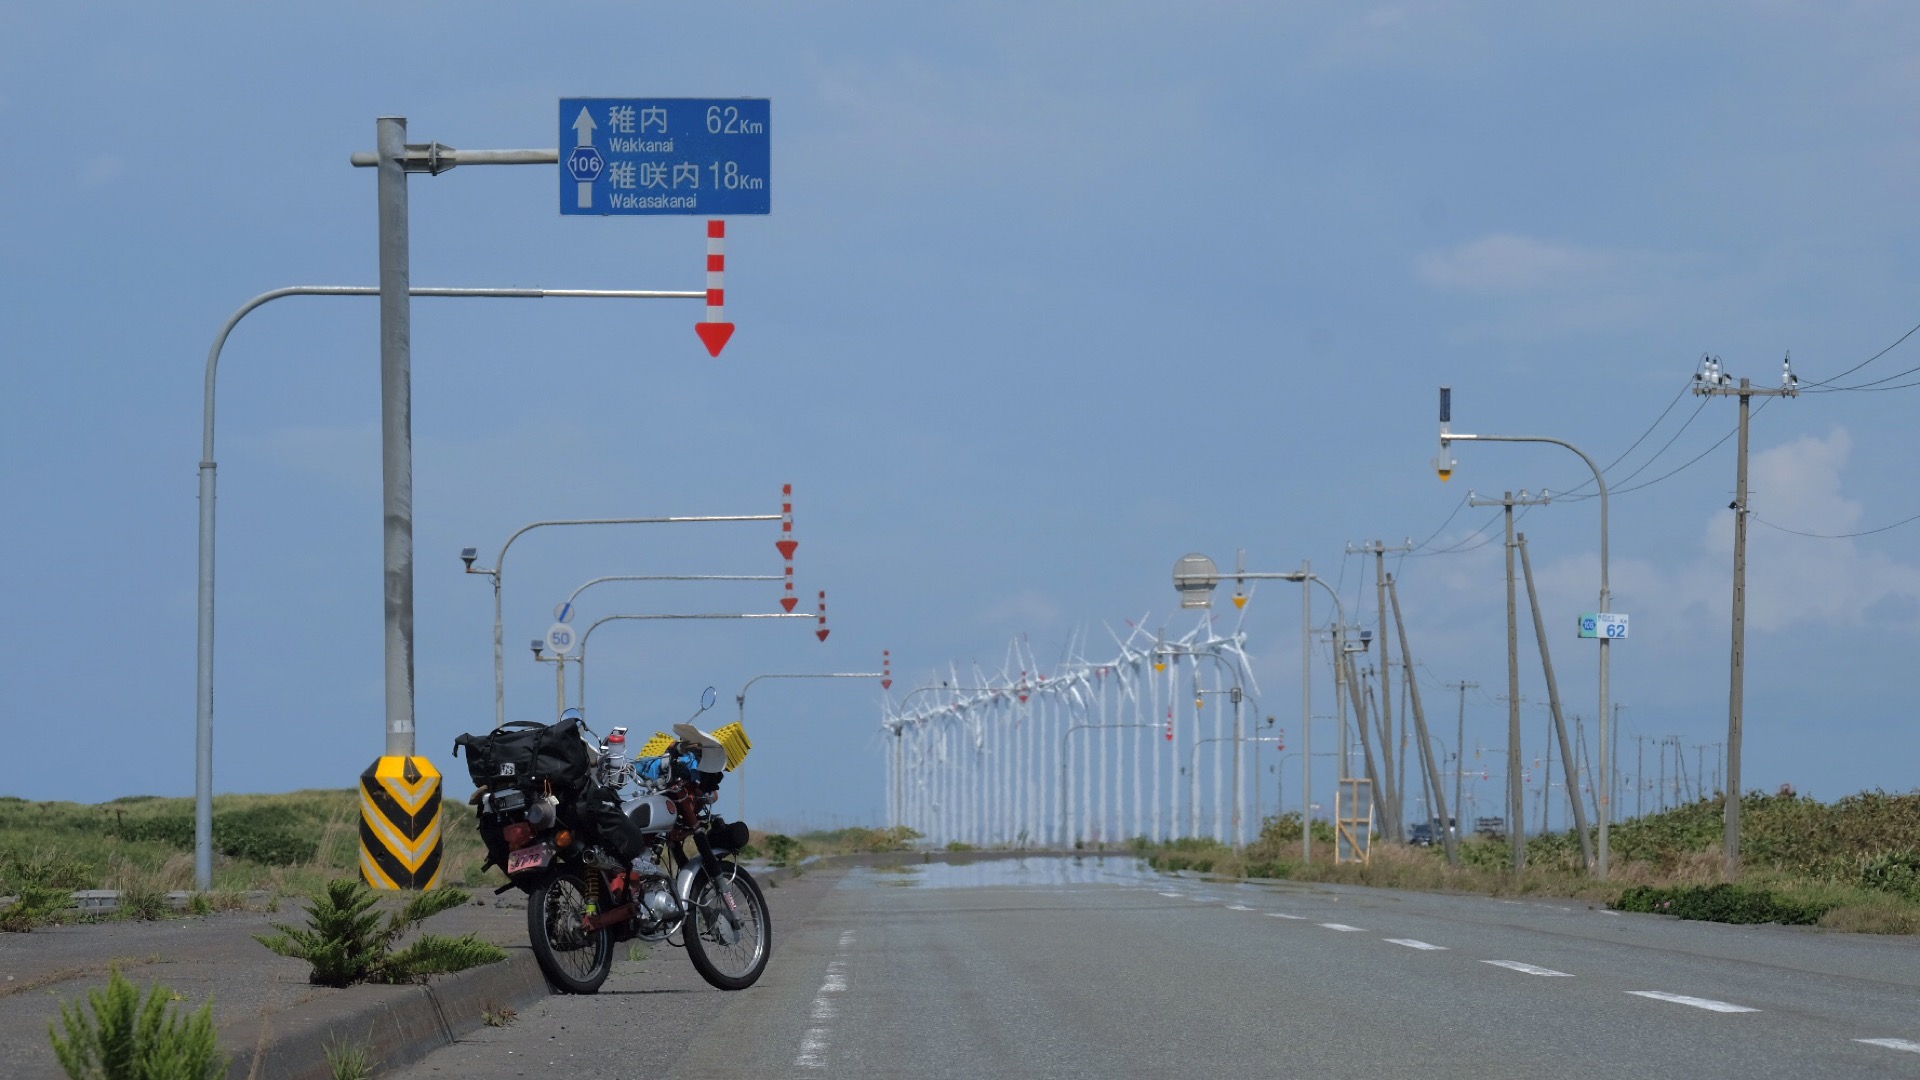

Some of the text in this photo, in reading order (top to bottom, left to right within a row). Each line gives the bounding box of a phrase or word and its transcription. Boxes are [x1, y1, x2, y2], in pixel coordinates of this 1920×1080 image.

[609, 105, 668, 134] 稚内
[609, 137, 674, 152] Wakkanai
[571, 157, 599, 172] 106
[609, 161, 699, 189] 稚咲内
[609, 193, 697, 208] Wakasakanai
[1606, 624, 1626, 637] 62
[552, 632, 570, 645] 50
